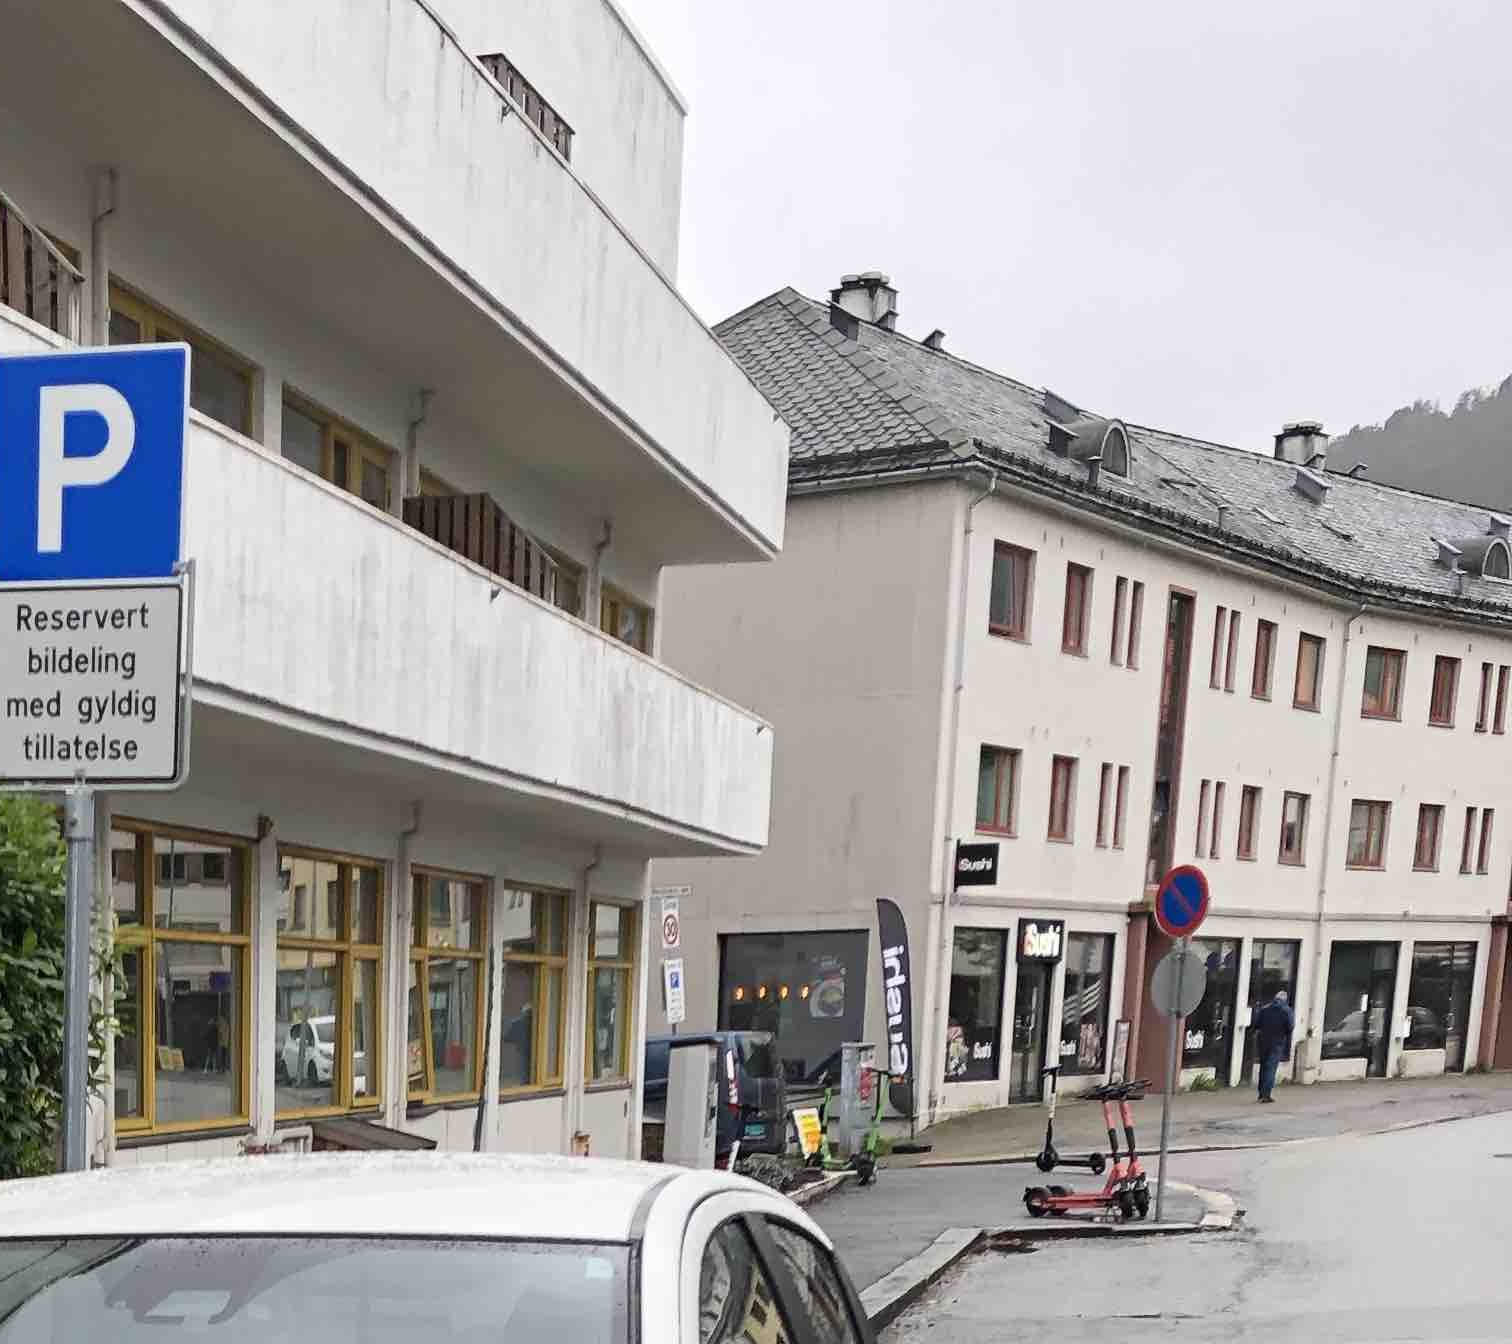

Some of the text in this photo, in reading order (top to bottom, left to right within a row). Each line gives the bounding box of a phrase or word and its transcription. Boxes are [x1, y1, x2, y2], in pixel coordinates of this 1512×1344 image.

[37, 383, 136, 553] P
[16, 602, 150, 632] Reservert
[27, 645, 137, 679] bildeling
[6, 689, 157, 724] med gyldig
[23, 733, 139, 761] tillatelse
